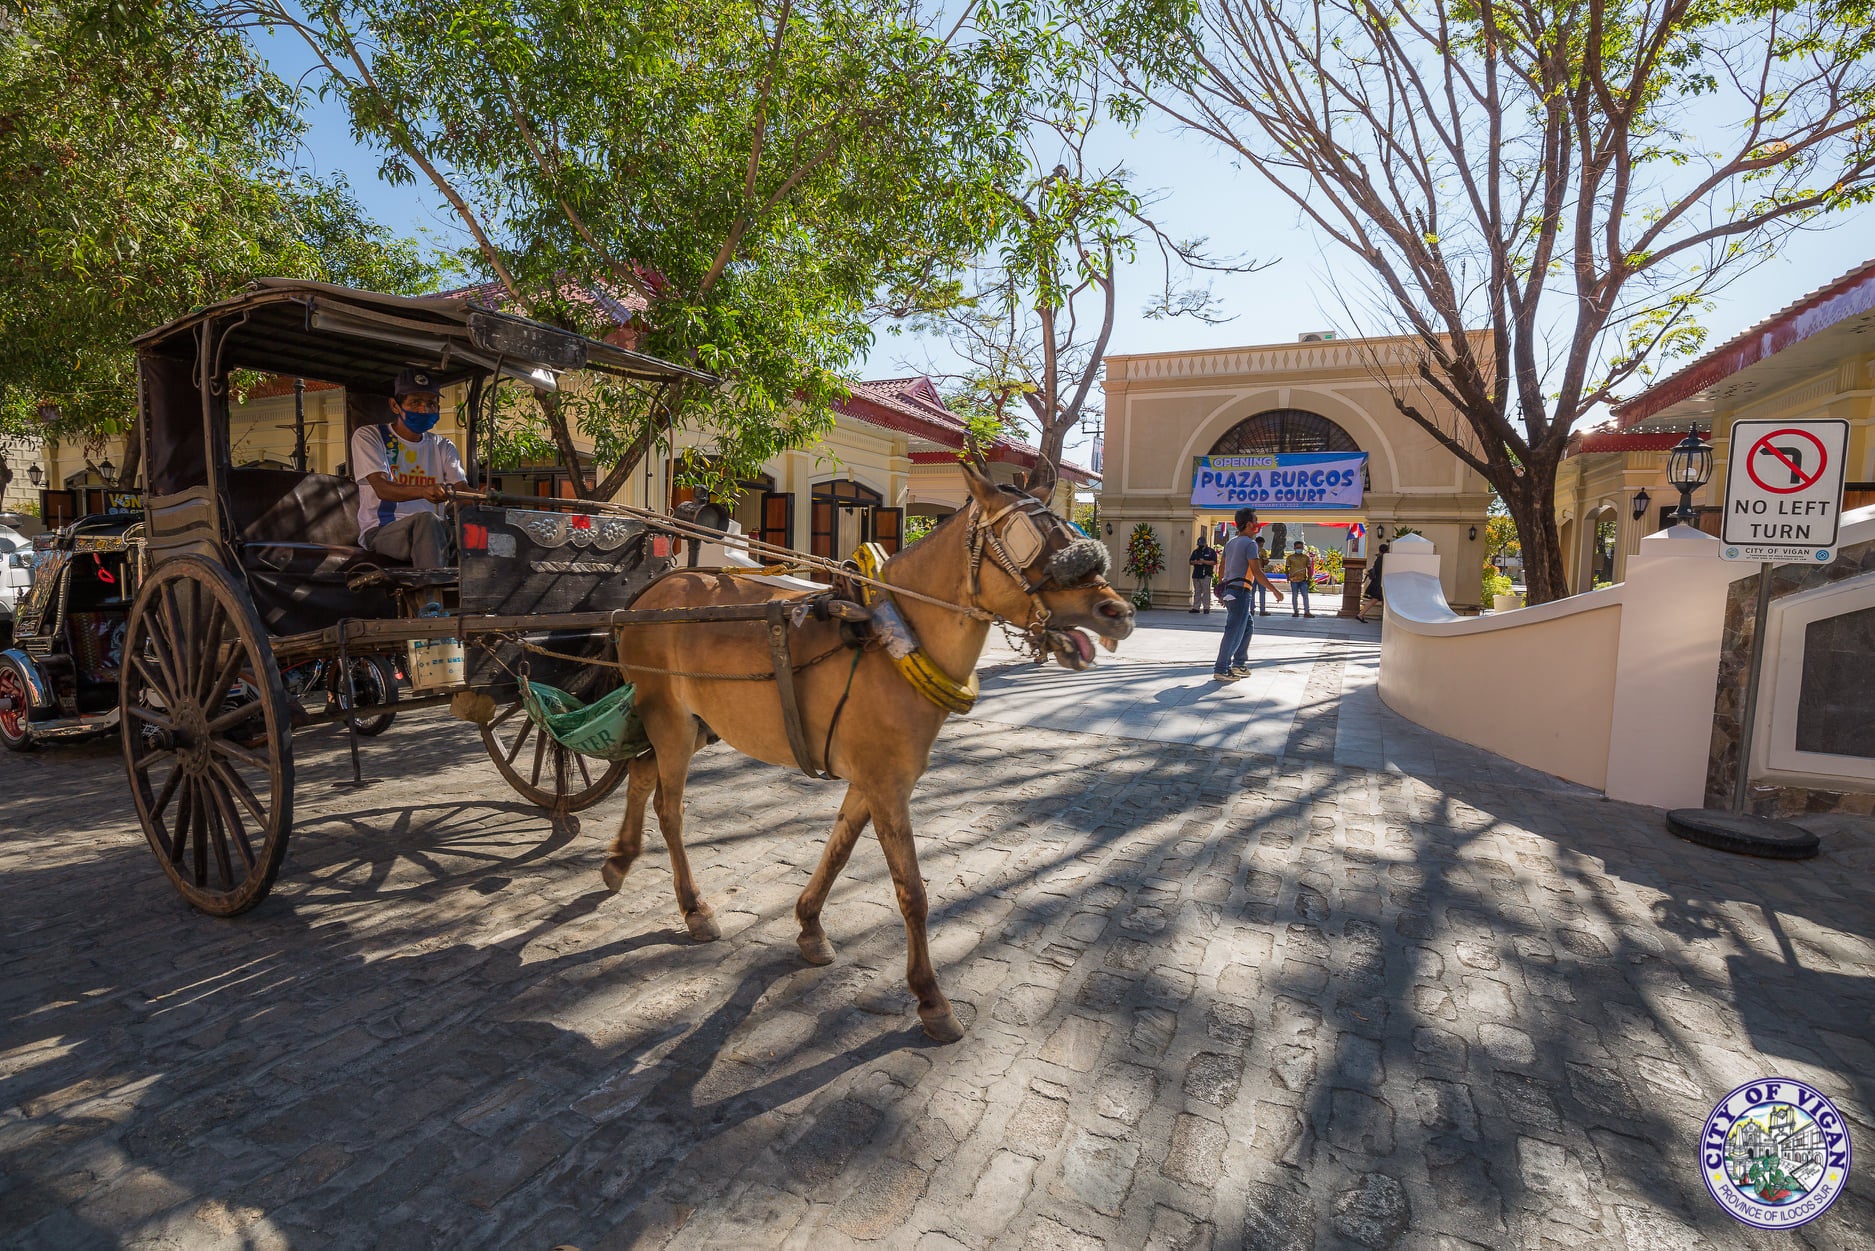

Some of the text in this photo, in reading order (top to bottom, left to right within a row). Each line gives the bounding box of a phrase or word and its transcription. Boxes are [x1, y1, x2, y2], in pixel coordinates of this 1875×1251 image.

[1213, 456, 1273, 468] OPENING
[1201, 469, 1355, 488] PLAZA BURGOS
[1228, 488, 1327, 502] FOOD COURT
[1735, 500, 1831, 515] NO LEFT
[1750, 523, 1811, 539] TURN
